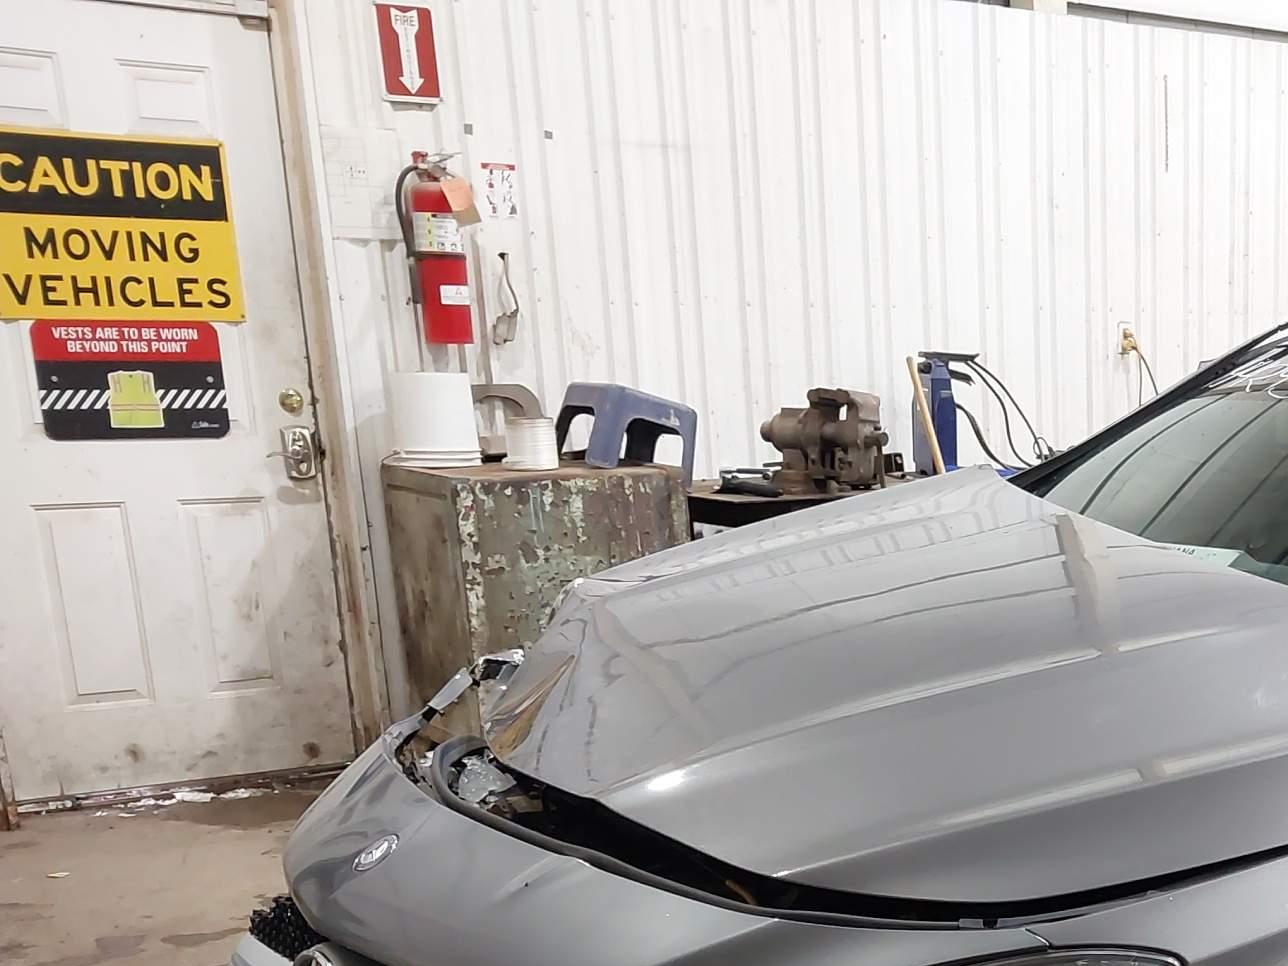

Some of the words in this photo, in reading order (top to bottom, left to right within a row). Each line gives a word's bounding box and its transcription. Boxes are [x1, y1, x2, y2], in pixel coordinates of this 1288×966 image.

[394, 14, 416, 27] FIRE
[0, 153, 214, 201] CAUTION
[24, 226, 200, 264] MOVING
[3, 273, 231, 308] VEHICLES
[51, 326, 93, 340] VESTS
[95, 327, 120, 340] ARE
[121, 327, 139, 340] TO
[142, 328, 158, 340] BE
[159, 328, 199, 341] WORN
[66, 340, 118, 353] BEYOND
[121, 340, 149, 353] THIS
[151, 341, 188, 354] POINT
